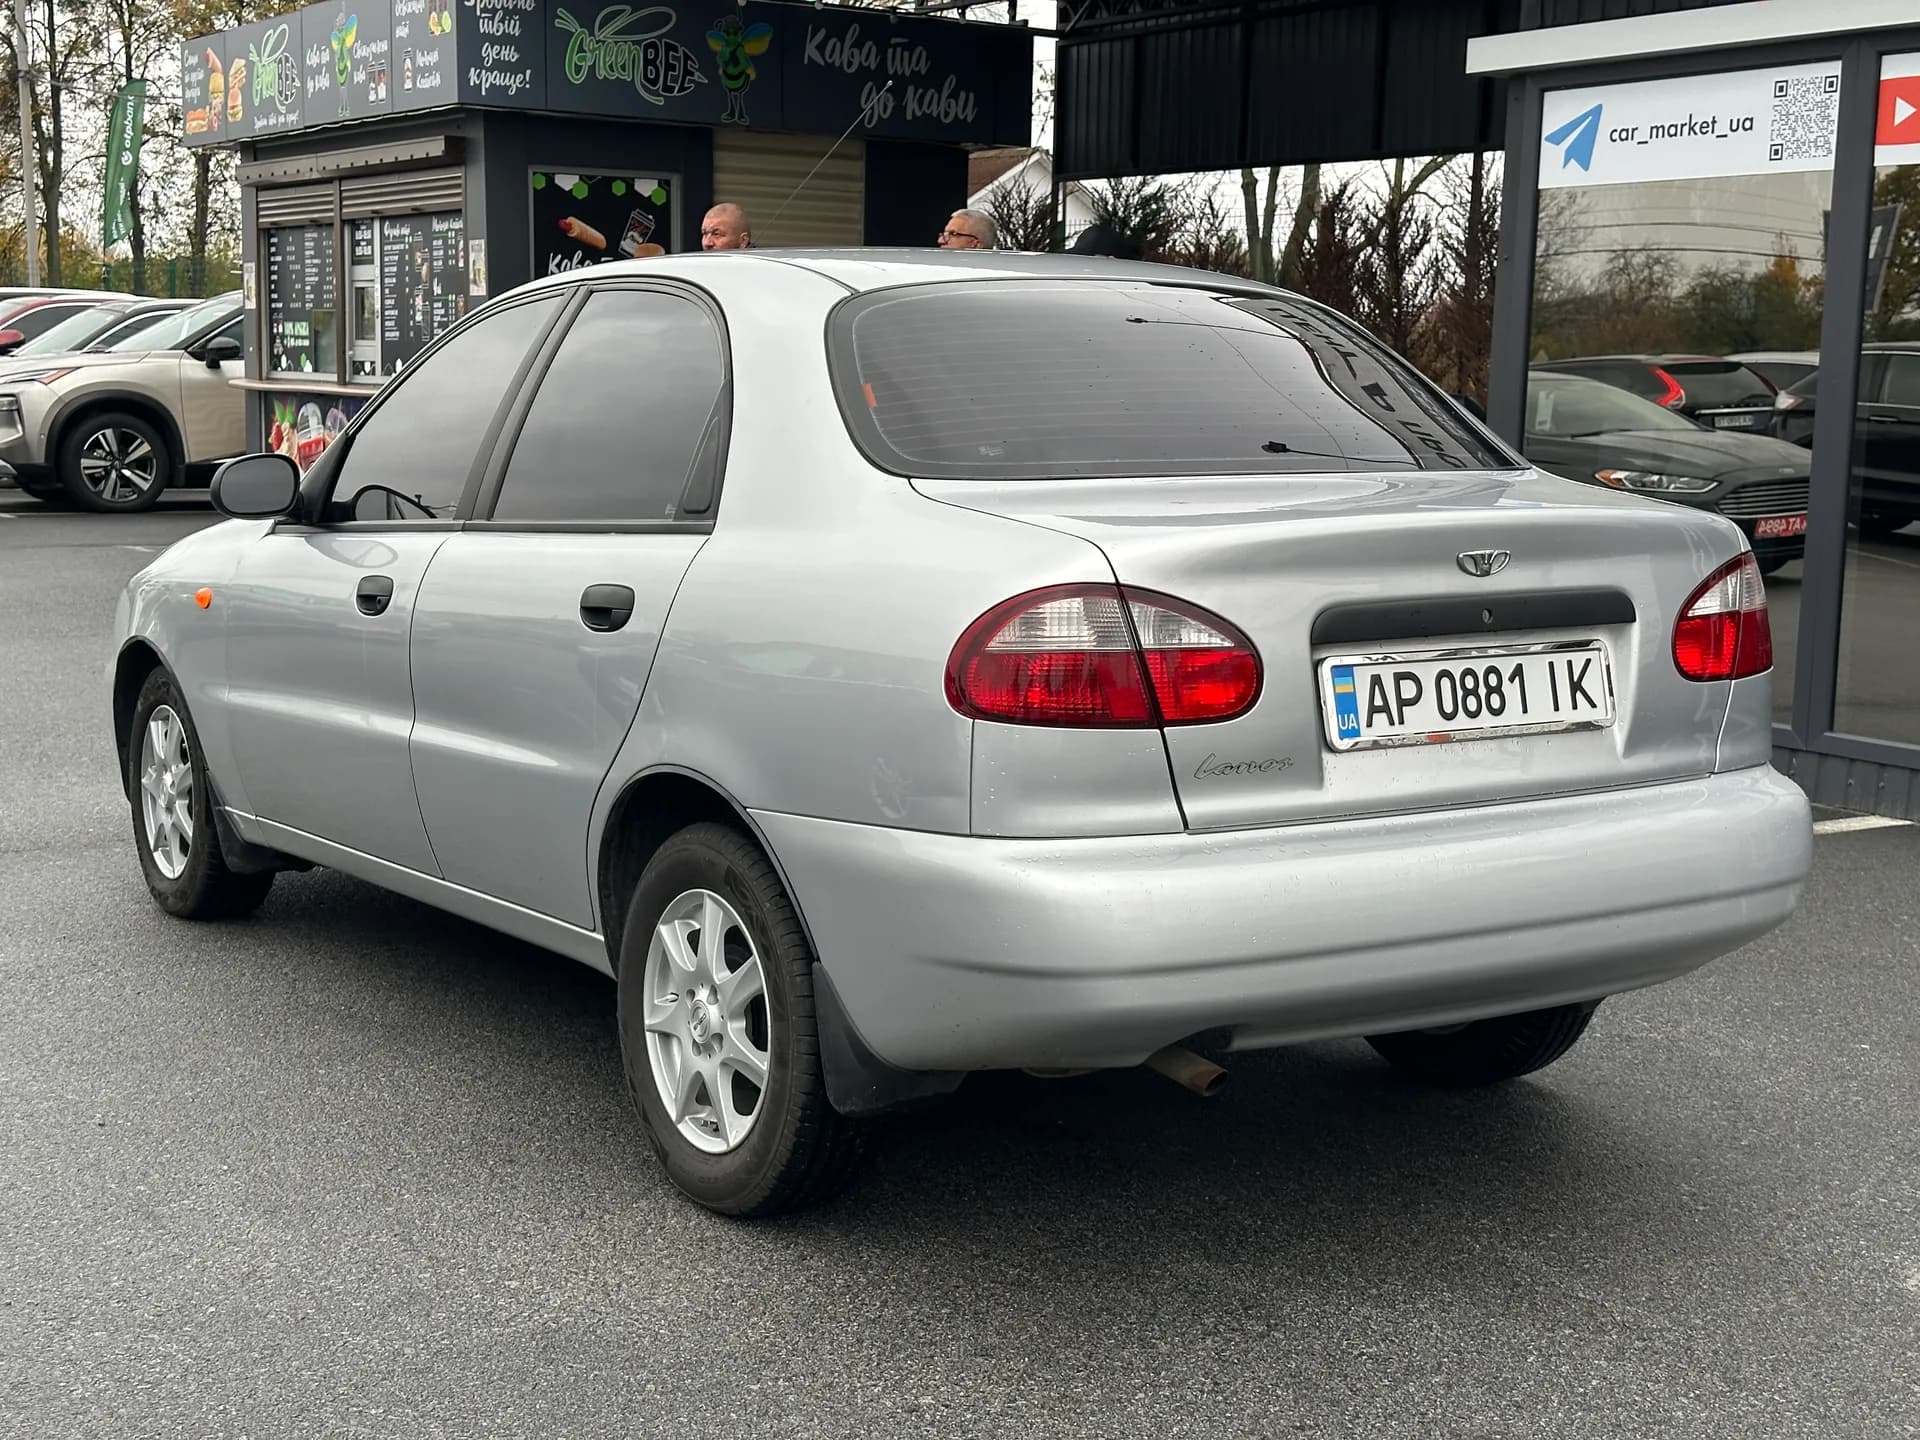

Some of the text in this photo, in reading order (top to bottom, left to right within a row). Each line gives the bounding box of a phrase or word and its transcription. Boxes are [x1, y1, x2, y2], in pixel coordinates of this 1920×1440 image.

[479, 10, 521, 37] твій
[481, 41, 520, 67] день
[804, 23, 931, 77] Кава та
[468, 67, 532, 96] краще!
[860, 74, 977, 128] до кави
[1609, 113, 1754, 145] car_market_ua
[1365, 657, 1598, 728] AP 0881 IK
[1338, 713, 1358, 730] UA
[1193, 752, 1293, 780] Lanos
